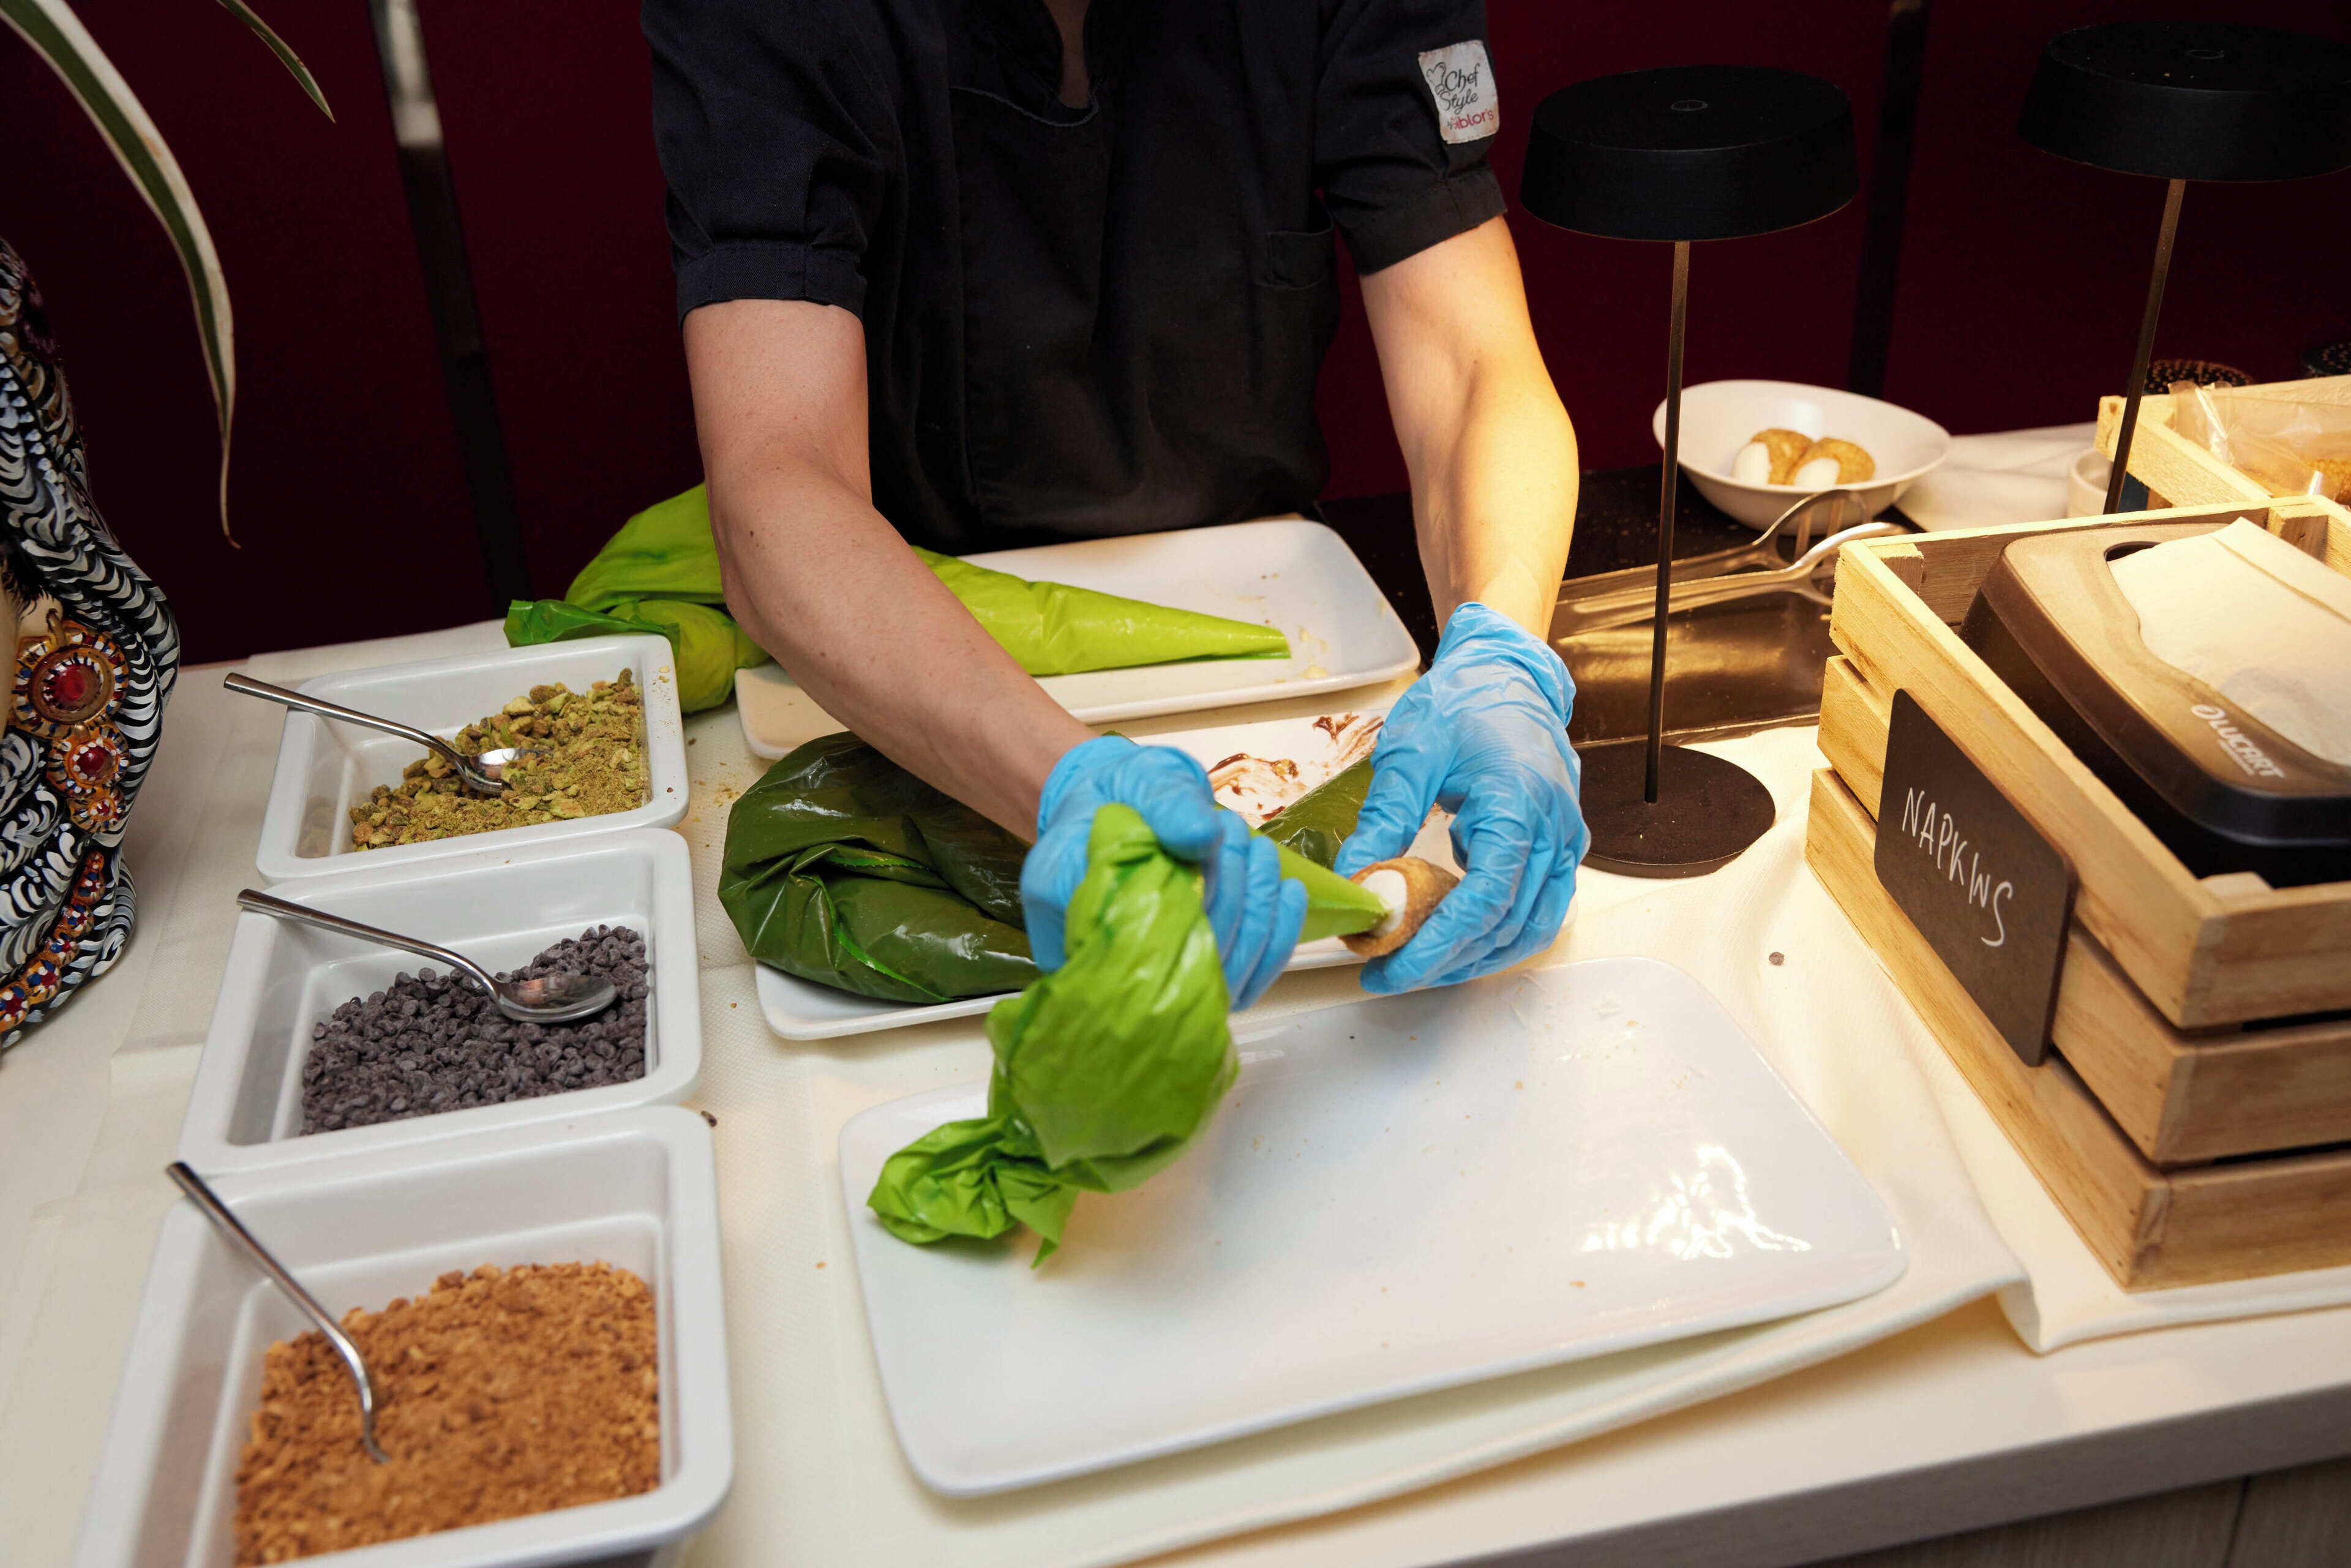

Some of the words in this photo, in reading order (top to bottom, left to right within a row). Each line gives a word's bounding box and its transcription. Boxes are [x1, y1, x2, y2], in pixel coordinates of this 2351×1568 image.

[1445, 62, 1480, 92] Chef
[1439, 88, 1479, 115] Style
[2208, 719, 2285, 778] LUCART
[1902, 787, 2013, 947] NAPKINS
